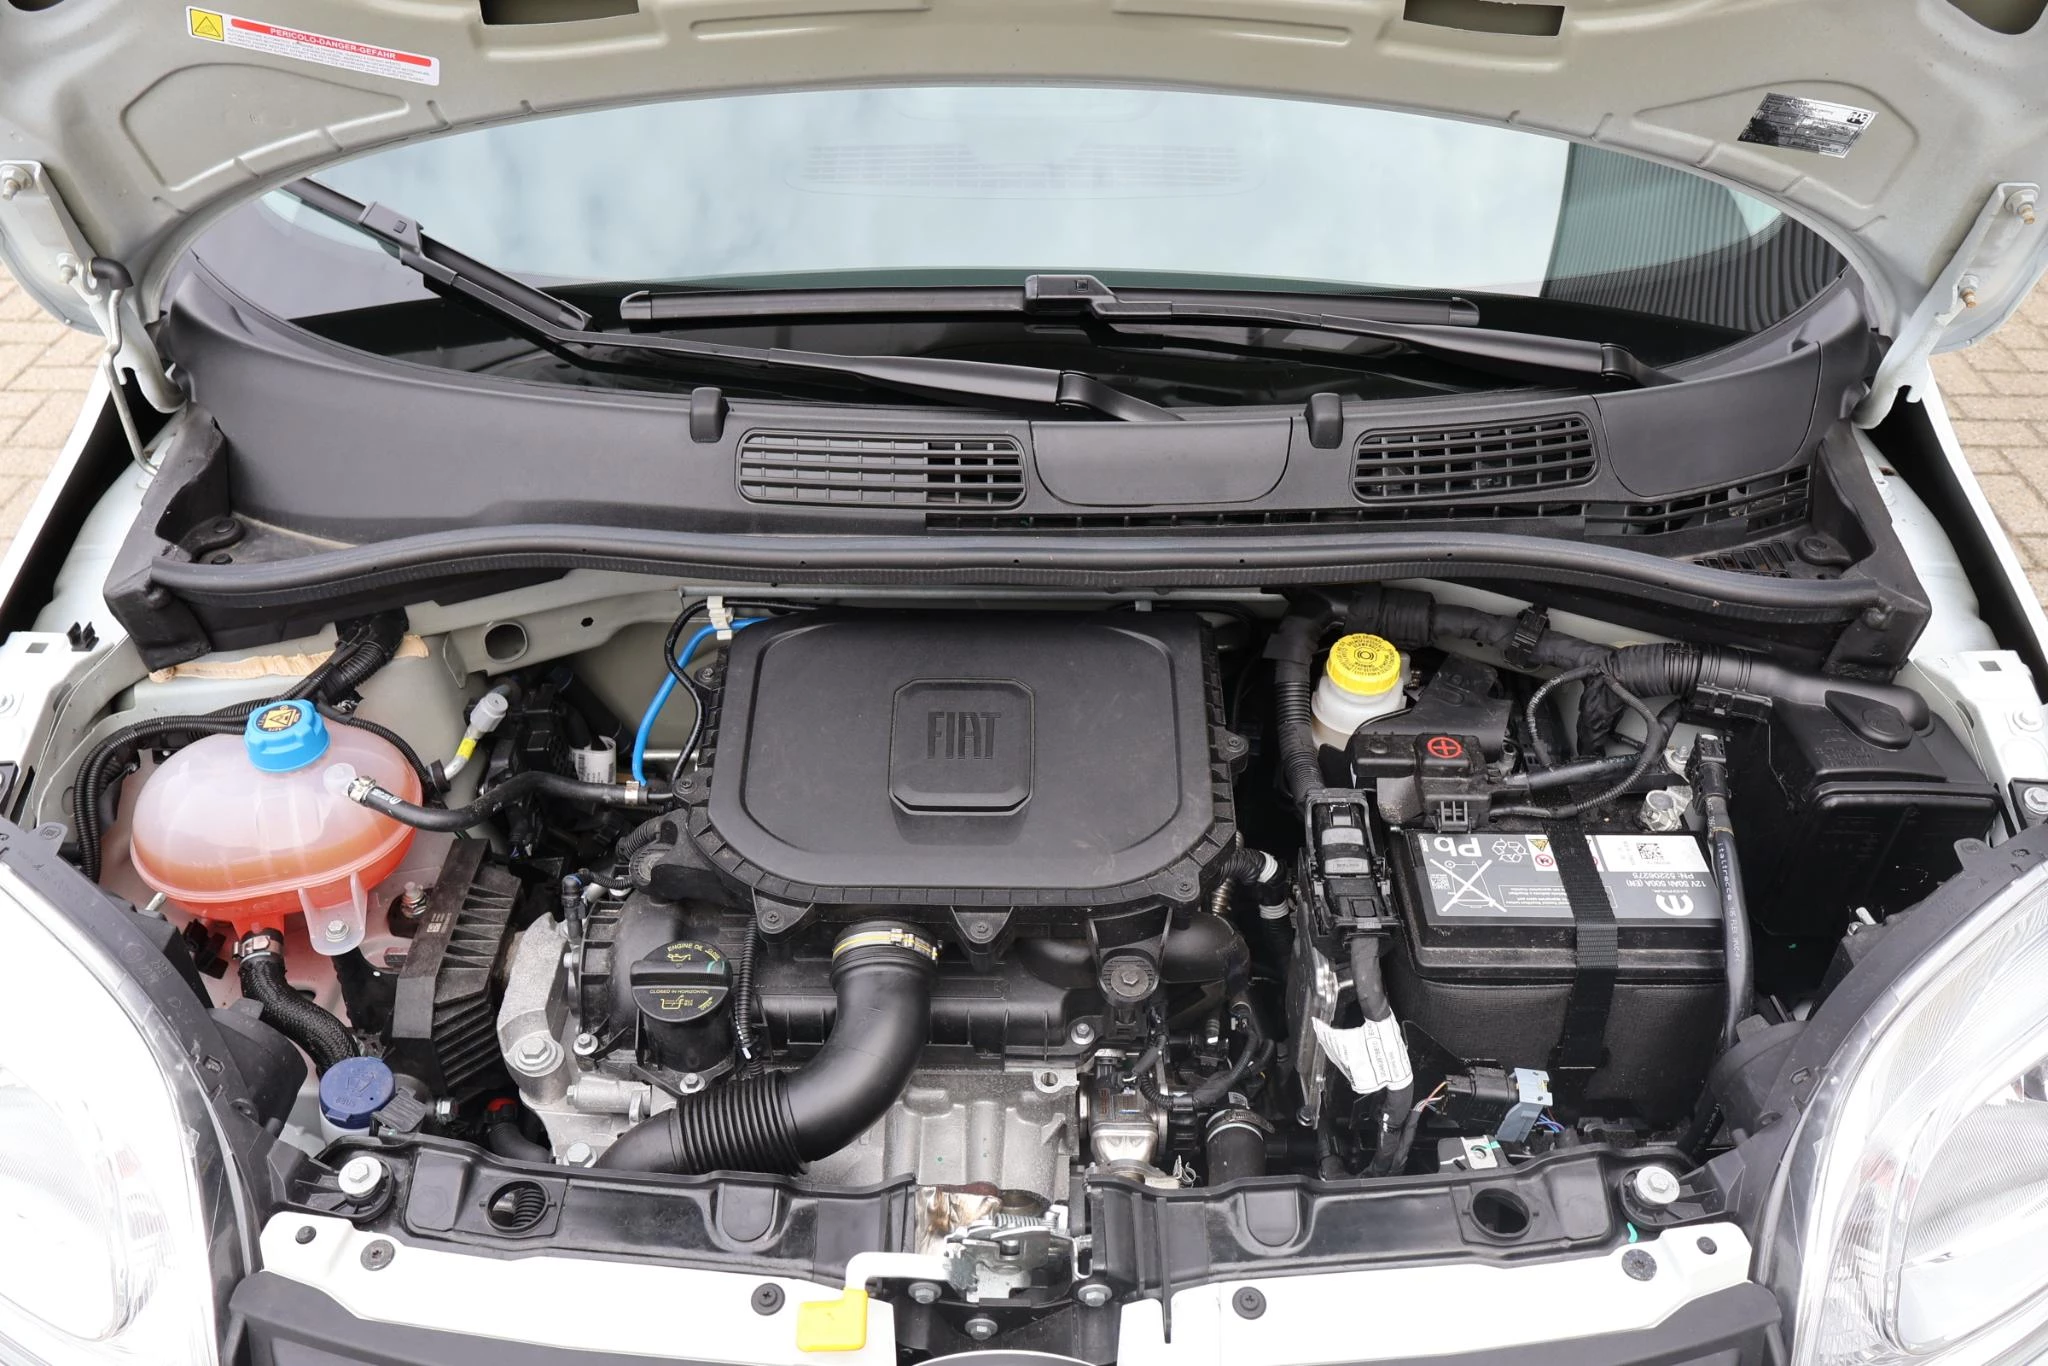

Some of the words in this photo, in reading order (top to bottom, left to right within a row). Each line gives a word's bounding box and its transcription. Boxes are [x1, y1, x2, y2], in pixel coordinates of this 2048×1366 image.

[269, 27, 397, 59] PERICOLO-DANGER-GEFAHR
[927, 711, 1002, 760] FIAT
[1434, 836, 1482, 857] Pb
[667, 943, 693, 952] ENGINE
